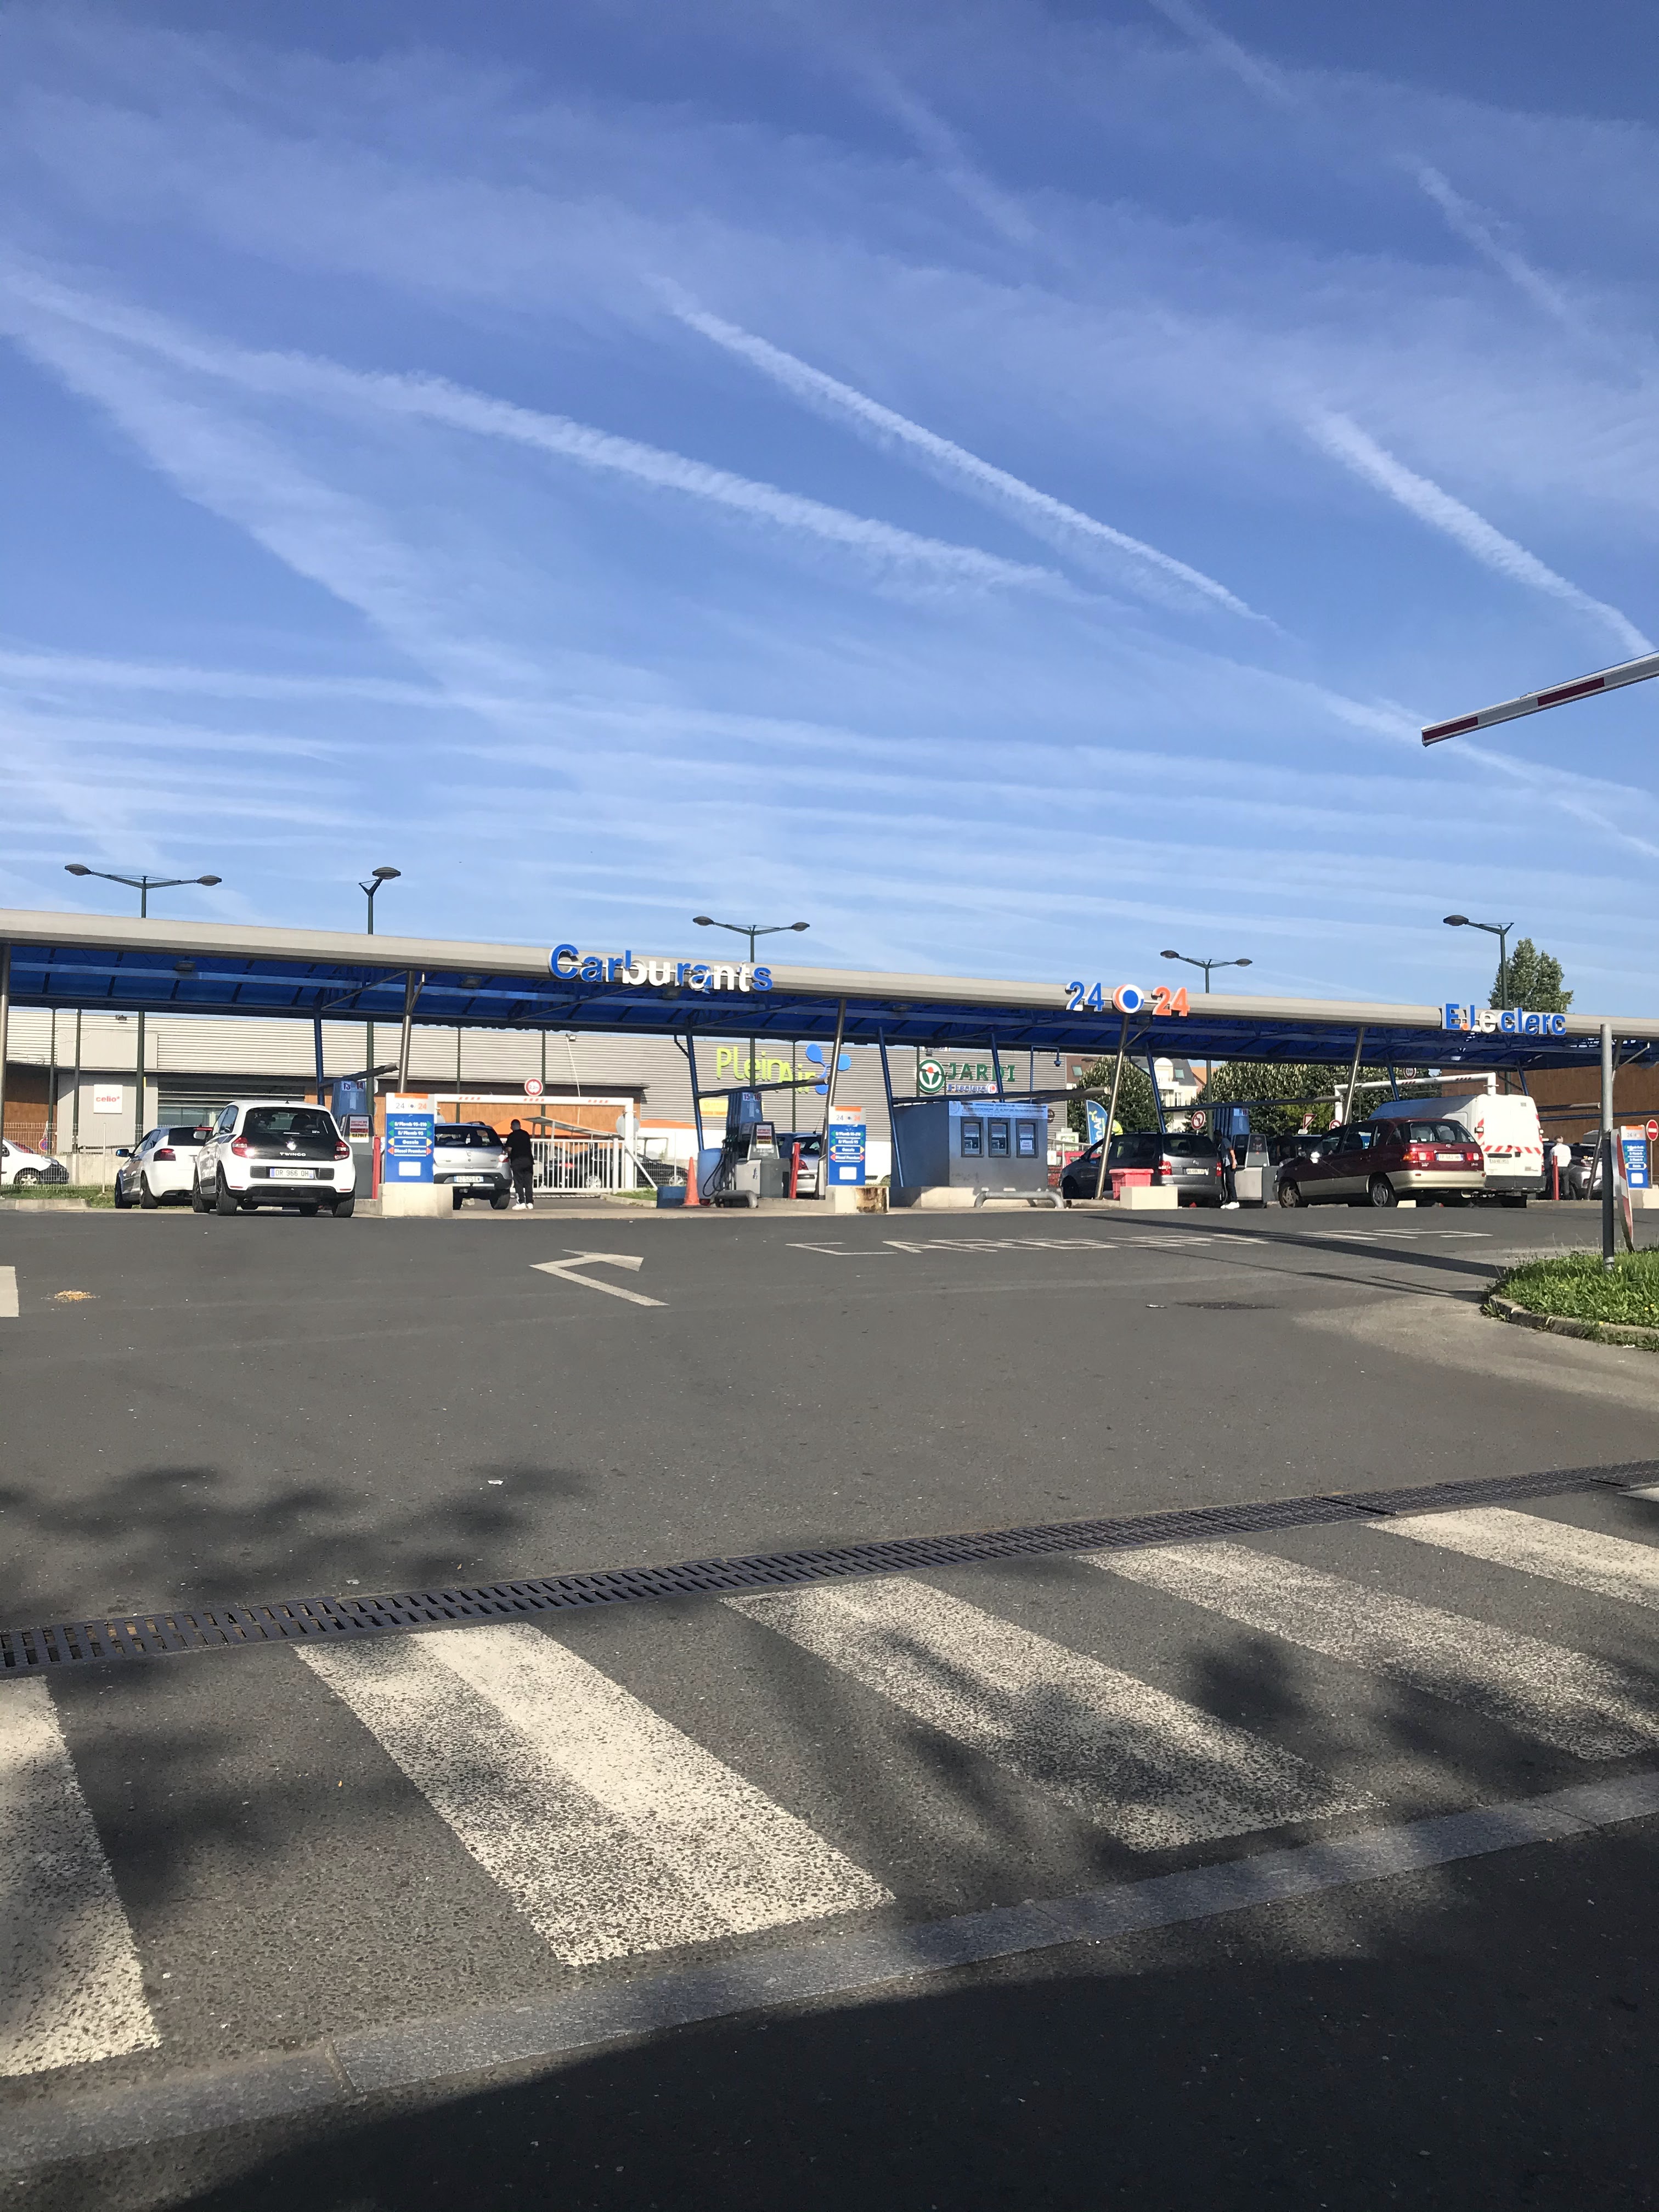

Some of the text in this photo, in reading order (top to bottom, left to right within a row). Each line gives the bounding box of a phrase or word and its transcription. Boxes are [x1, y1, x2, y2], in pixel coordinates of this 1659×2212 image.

[548, 944, 774, 994] Carburants
[1065, 981, 1191, 1017] 24 24
[1441, 1003, 1567, 1035] E.Leclerc
[716, 1046, 782, 1081] Plein
[947, 1062, 1015, 1082] JARDI
[356, 1081, 364, 1090] 14
[785, 1228, 1493, 1255] CARBURANTS
